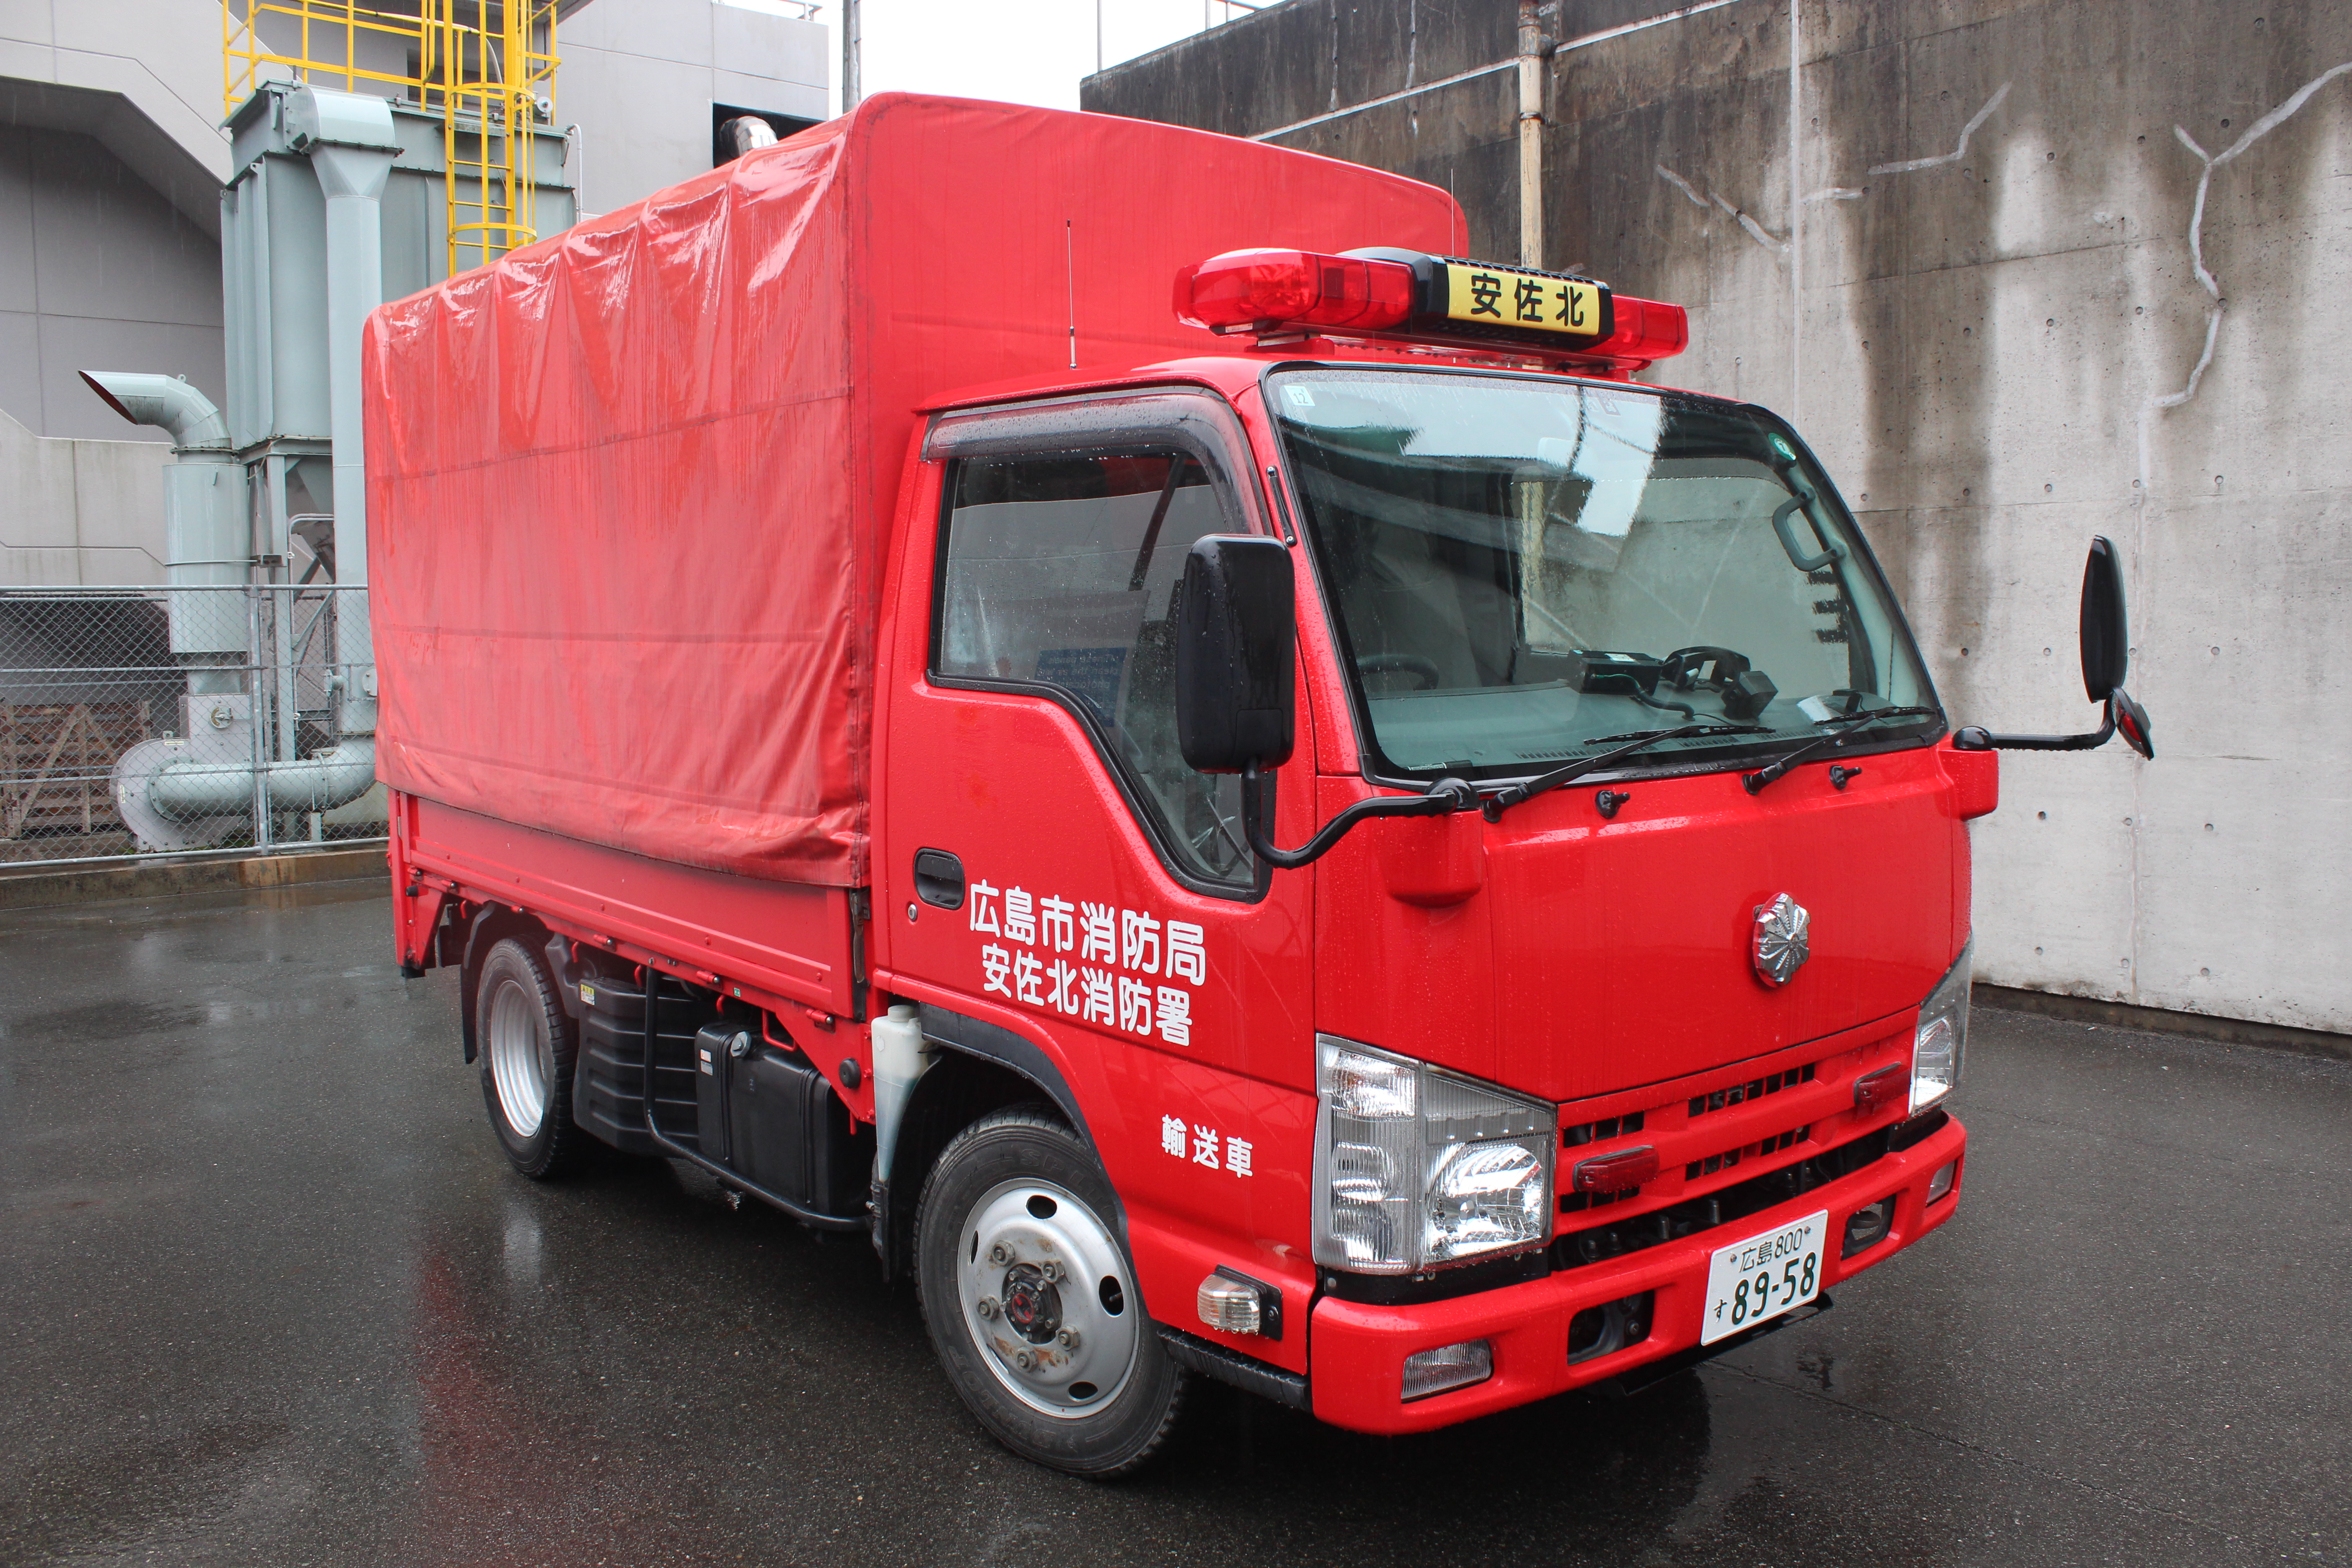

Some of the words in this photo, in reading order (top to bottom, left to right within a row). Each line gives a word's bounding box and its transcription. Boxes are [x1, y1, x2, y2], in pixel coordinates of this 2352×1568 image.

[1470, 273, 1584, 327] 安佐北
[1293, 392, 1309, 404] 12
[970, 879, 1206, 986] 広島市消防局
[982, 942, 1192, 1047] 安佐北消防署
[1162, 1114, 1253, 1178] 輸送車
[1713, 1298, 1727, 1323] す
[1731, 1251, 1816, 1325] 89-58
